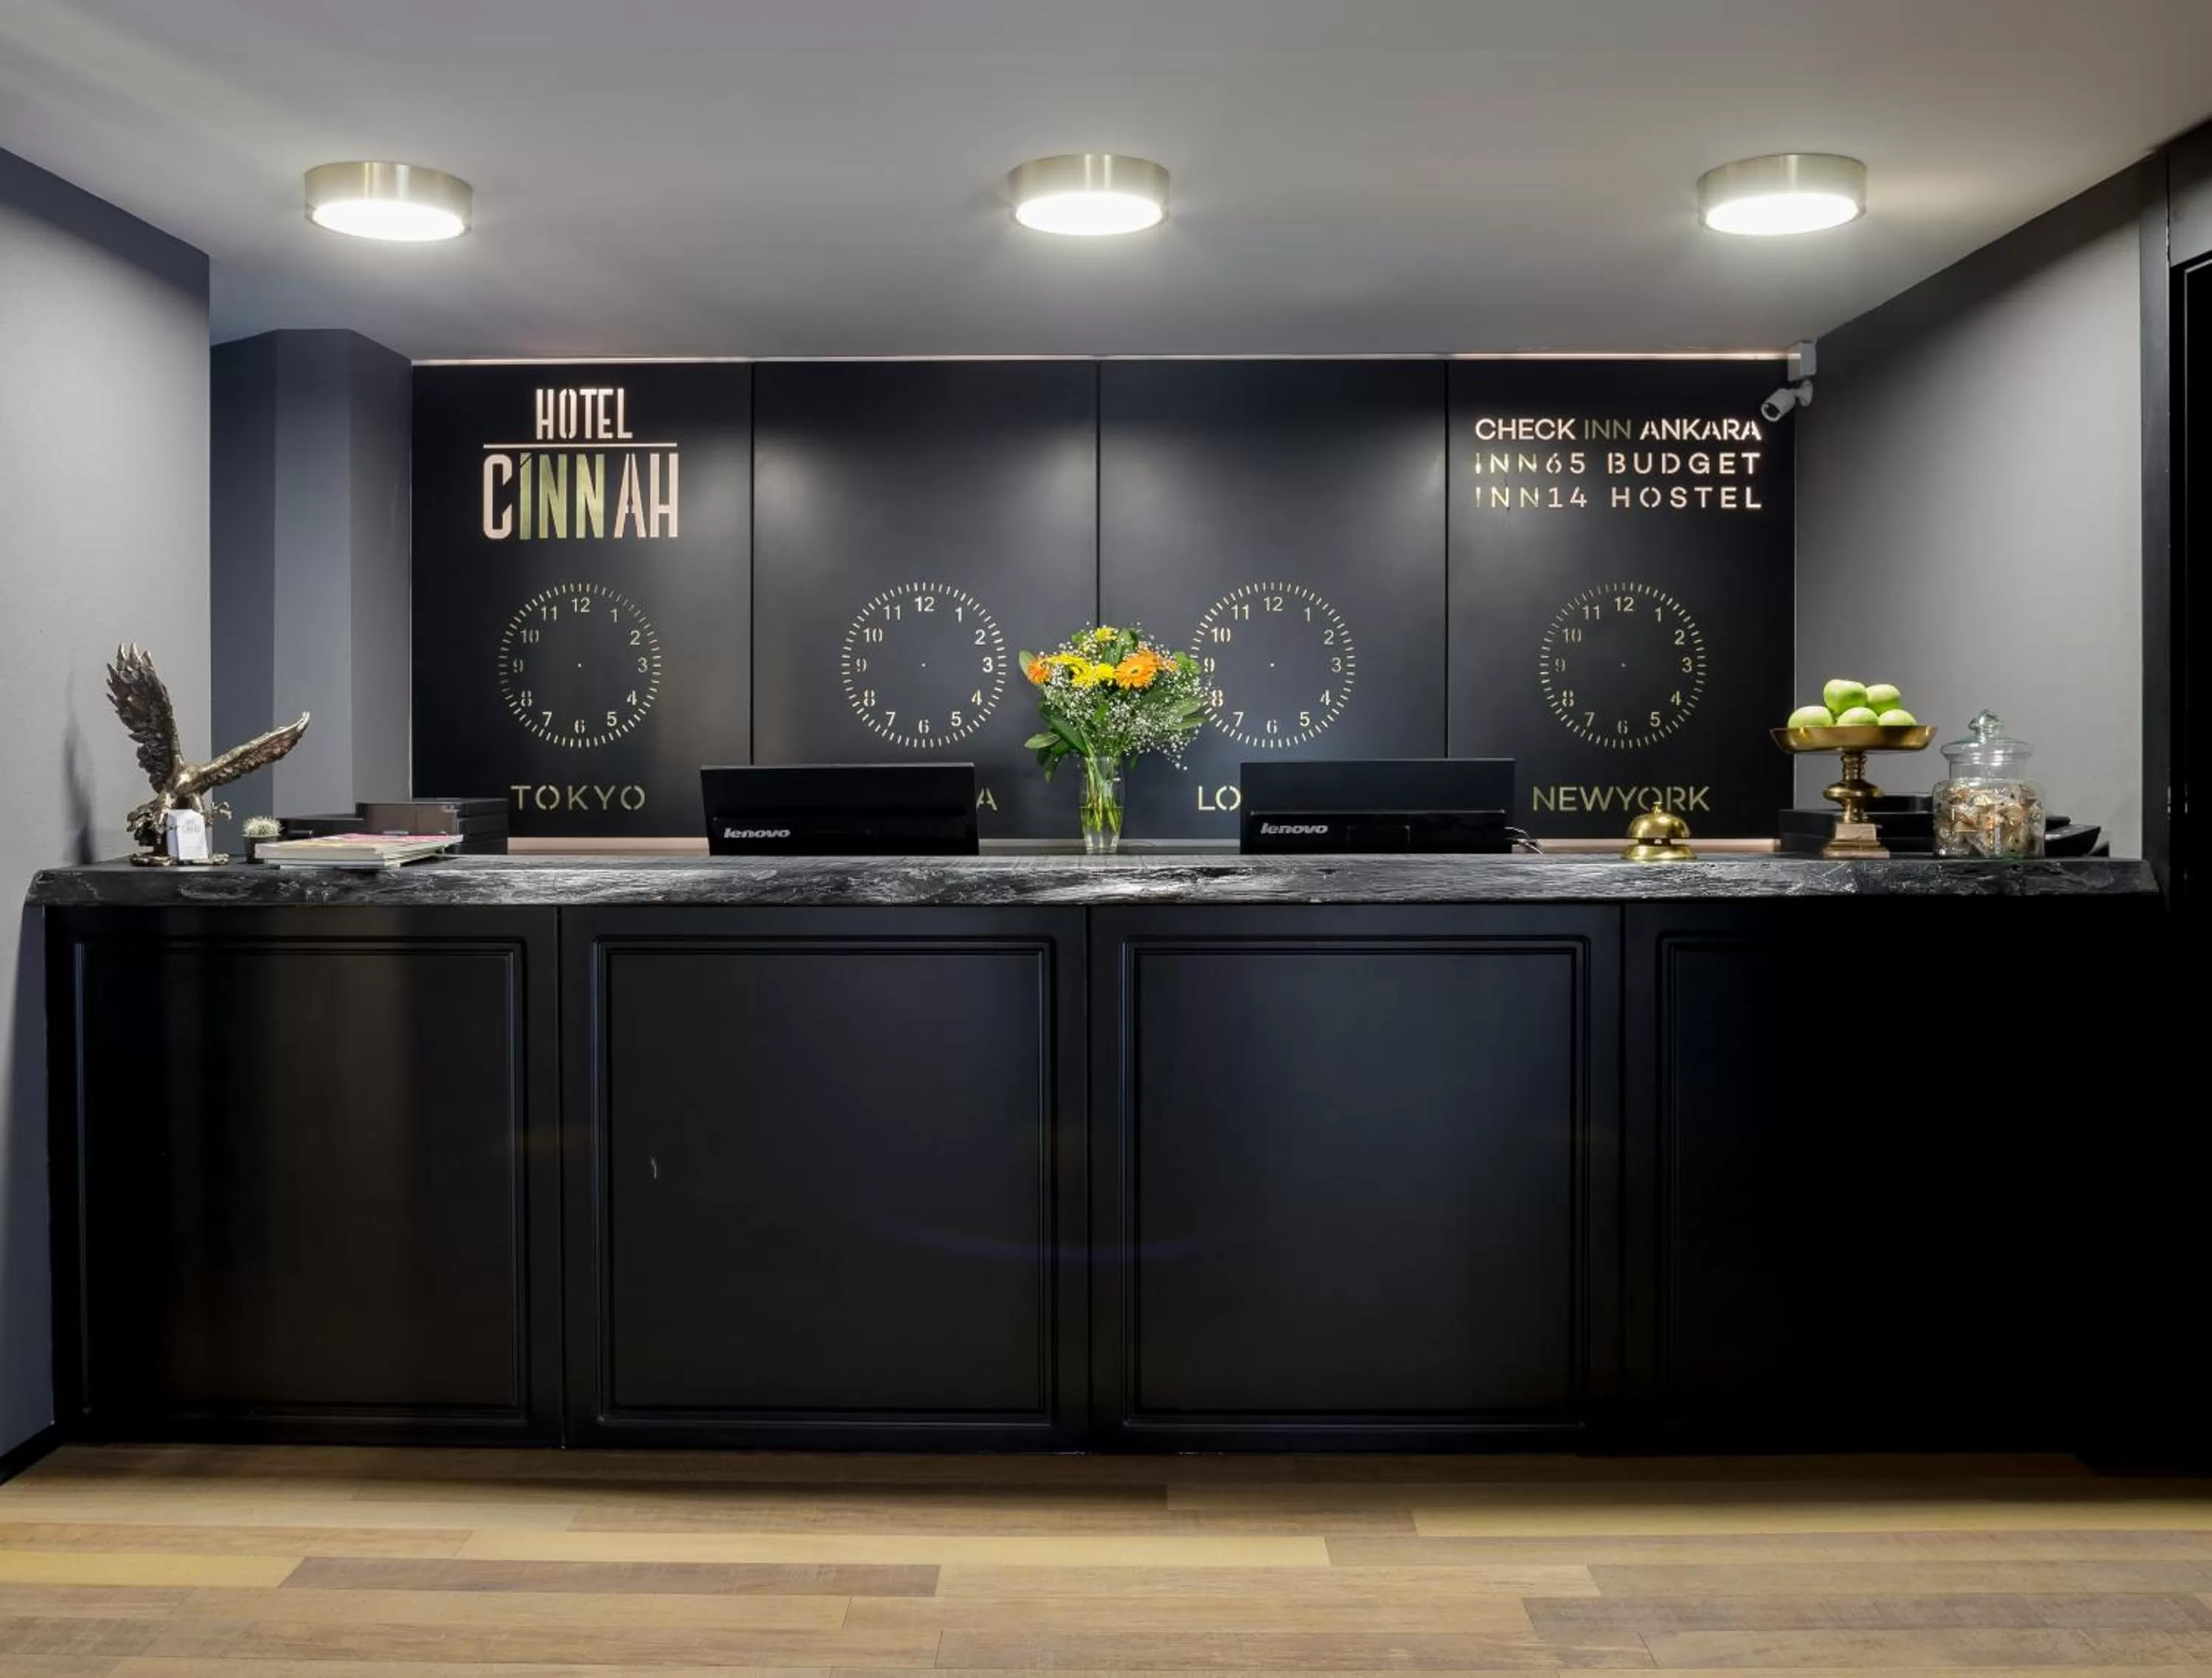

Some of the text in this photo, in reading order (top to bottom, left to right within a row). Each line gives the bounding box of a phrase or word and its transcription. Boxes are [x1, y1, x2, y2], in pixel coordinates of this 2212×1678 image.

[535, 388, 633, 440] HOTEL
[1475, 418, 1761, 441] CHECK INN ANKARA
[1475, 452, 1761, 474] INN65 BUDGET
[1475, 487, 1762, 509] INN14 HOSTEL
[572, 597, 591, 613] 12
[914, 596, 934, 612] 12
[1263, 596, 1284, 611] 12
[1615, 596, 1634, 611] 12
[540, 606, 557, 622] 11
[611, 608, 618, 623] 1
[883, 605, 900, 620] 11
[956, 608, 962, 622] 1
[1231, 605, 1249, 620] 11
[1304, 608, 1311, 622] 1
[1582, 605, 1600, 620] 11
[1655, 608, 1661, 622] 1
[521, 630, 540, 643] 10
[630, 630, 641, 645] 2
[863, 628, 883, 643] 10
[975, 630, 985, 645] 2
[1211, 627, 1231, 643] 10
[1324, 630, 1334, 644] 2
[1562, 628, 1582, 644] 10
[1675, 630, 1685, 645] 2
[513, 658, 524, 672] 9
[638, 657, 648, 673] 3
[856, 658, 867, 672] 9
[983, 657, 993, 672] 3
[1204, 658, 1214, 672] 9
[1332, 658, 1341, 672] 3
[1555, 658, 1565, 672] 9
[1682, 657, 1692, 672] 3
[521, 690, 532, 707] 8
[627, 690, 637, 705] 4
[863, 690, 875, 707] 8
[972, 690, 982, 706] 4
[1211, 690, 1223, 707] 8
[1320, 690, 1330, 706] 4
[1562, 690, 1574, 707] 8
[1671, 690, 1681, 706] 4
[542, 711, 552, 727] 7
[607, 711, 617, 726] 5
[886, 711, 896, 727] 7
[951, 711, 961, 726] 5
[1233, 711, 1244, 727] 7
[1300, 712, 1310, 727] 5
[1585, 711, 1595, 727] 7
[1650, 712, 1660, 727] 5
[574, 720, 585, 734] 6
[918, 719, 930, 734] 6
[1267, 720, 1277, 734] 6
[1618, 720, 1627, 734] 6
[510, 785, 645, 810] TOKYO
[1533, 786, 1711, 811] NEWYORK
[723, 828, 791, 839] lenovo
[1260, 823, 1328, 835] lenovo
